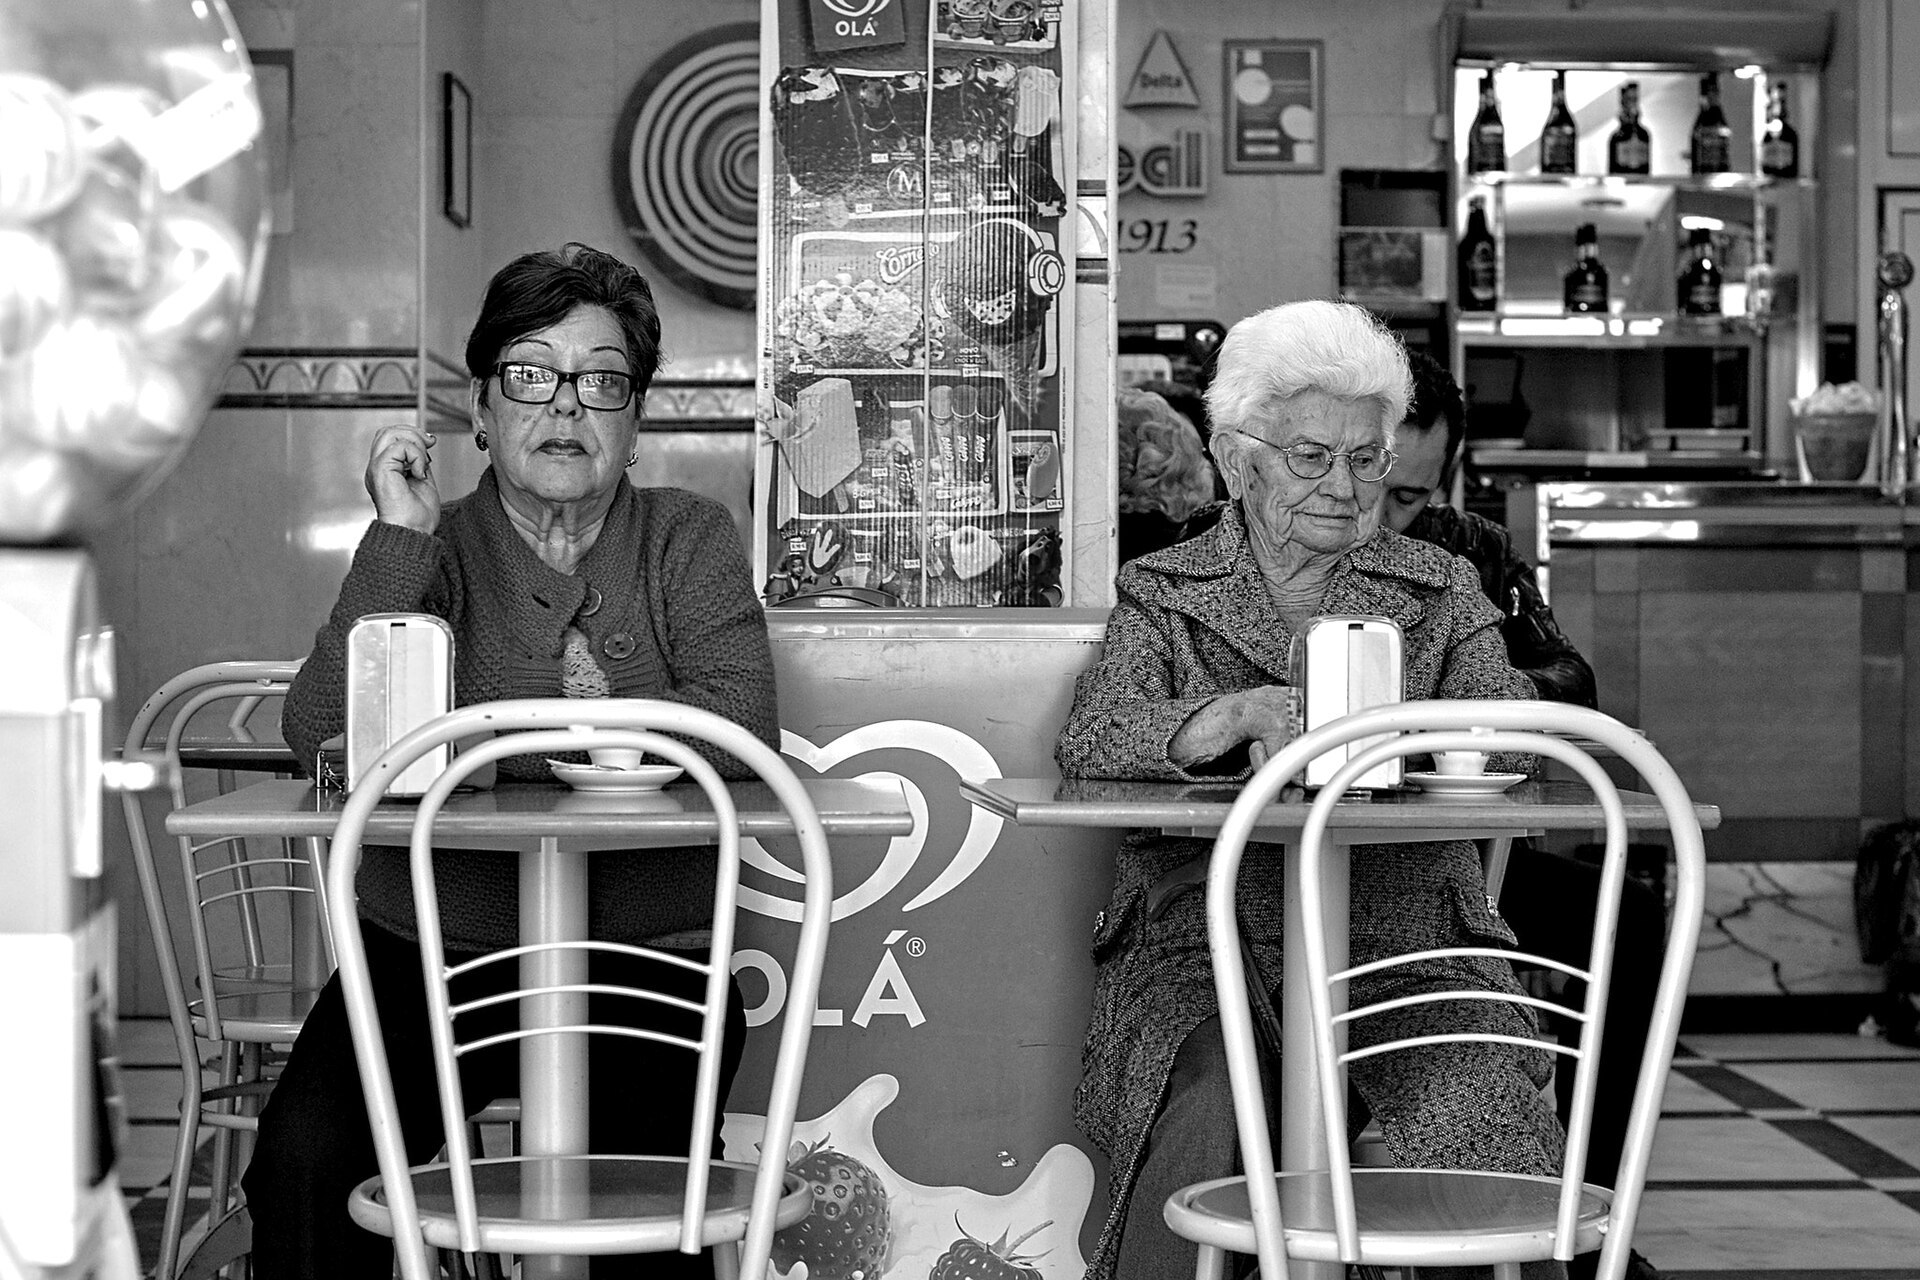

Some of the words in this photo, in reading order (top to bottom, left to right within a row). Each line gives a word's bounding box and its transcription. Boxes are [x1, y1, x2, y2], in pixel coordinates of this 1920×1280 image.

[835, 17, 877, 36] OLÁ
[1140, 72, 1182, 88] Delta
[1118, 218, 1198, 254] 1913
[875, 243, 940, 285] Corneo
